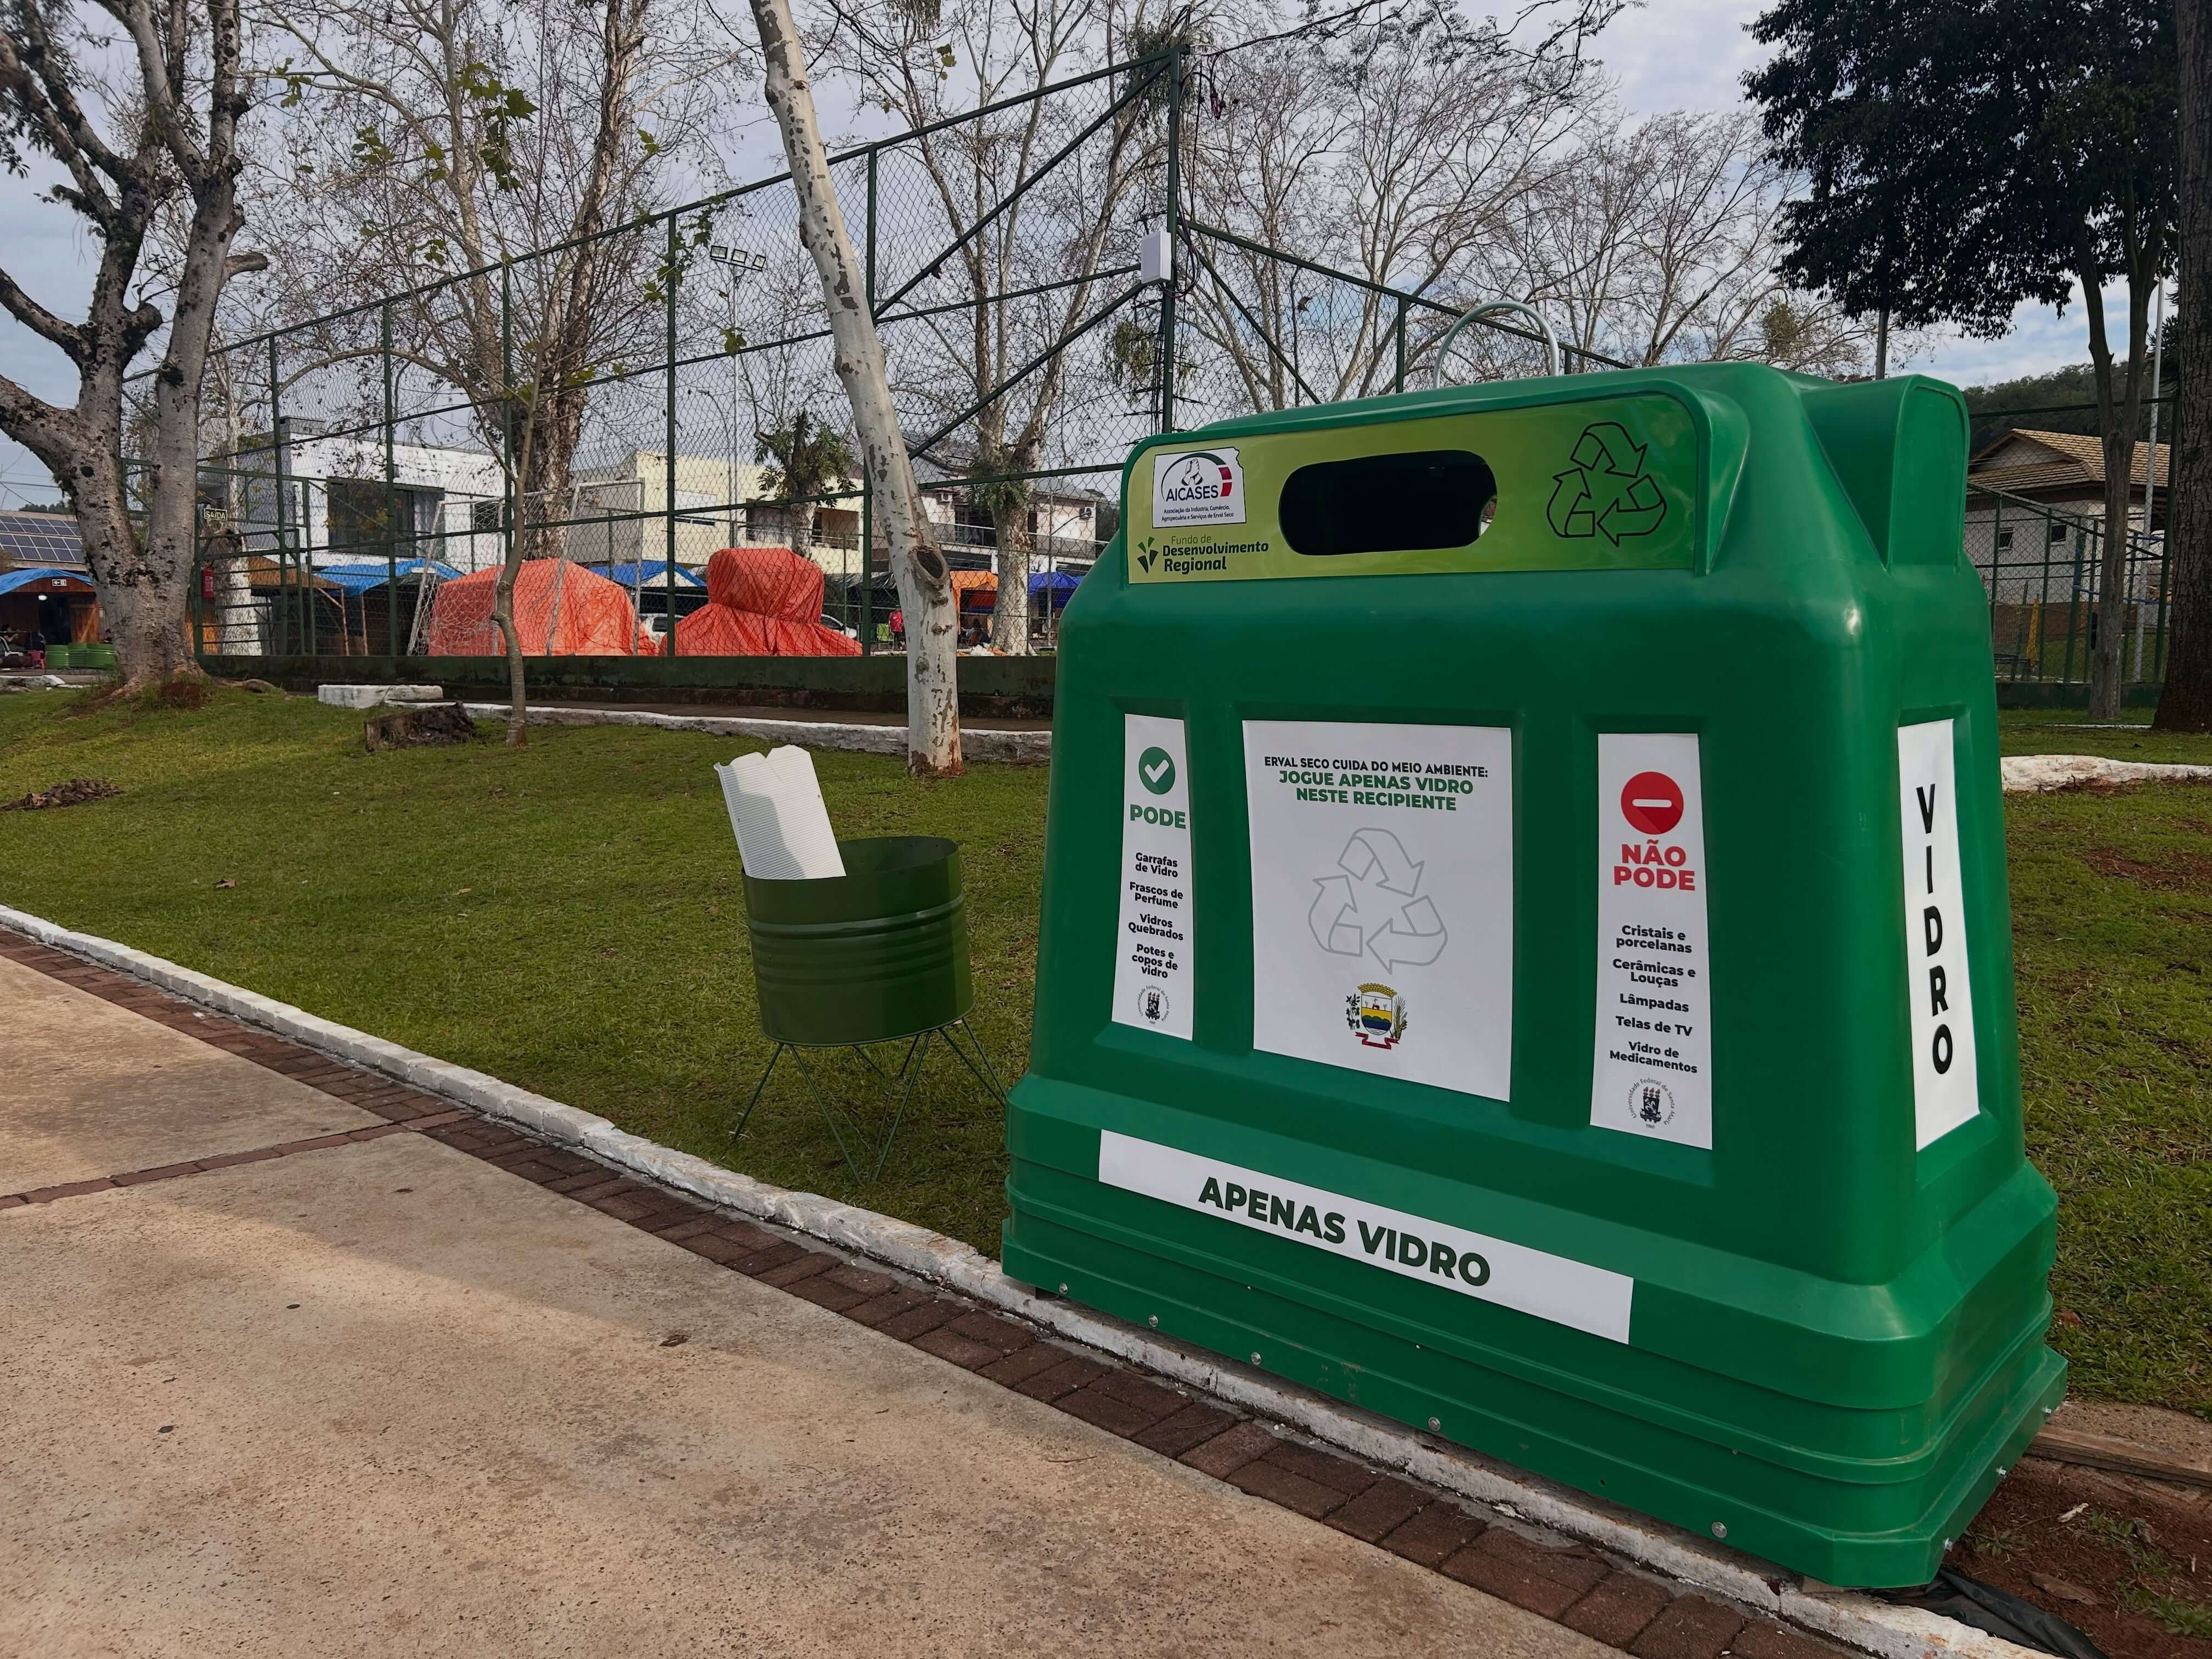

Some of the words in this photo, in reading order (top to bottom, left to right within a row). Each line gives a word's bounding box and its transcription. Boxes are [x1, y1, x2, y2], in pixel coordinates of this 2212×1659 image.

[1166, 485, 1218, 501] AICASES
[1163, 541, 1269, 556] Desenvolvimento
[1171, 534, 1198, 545] Fundo
[1200, 534, 1211, 543] de
[1164, 556, 1227, 574] Regional
[1264, 756, 1298, 768] ERVAL
[1300, 758, 1330, 769] SECO
[1333, 759, 1368, 771] CUIDA
[1371, 761, 1389, 771] DO
[1392, 761, 1421, 774] MEIO
[1425, 763, 1488, 777] AMBIENTE:
[1279, 770, 1334, 786] JOGUE
[1339, 774, 1411, 790] APENAS
[1415, 777, 1474, 794] VIDRO
[1296, 787, 1348, 804] NESTE
[1353, 791, 1457, 811] RECIPIENTE
[1130, 804, 1186, 829] PODE
[1135, 852, 1178, 867] Garrafas
[1621, 839, 1686, 867] NÃO
[1135, 862, 1148, 872] de
[1150, 865, 1178, 878] Vidro
[1613, 866, 1695, 891] PODE
[1130, 881, 1168, 896] Frascos
[1170, 887, 1183, 900] de
[1135, 893, 1178, 909] Perfume
[1139, 913, 1173, 928] Vidros
[1916, 783, 1953, 1075] VIDRO
[1128, 922, 1183, 941] Quebrados
[1622, 924, 1674, 940] Cristais
[1677, 932, 1686, 941] e
[1136, 943, 1165, 958] Potes
[1168, 951, 1175, 960] e
[1616, 936, 1692, 953] porcelanas
[1132, 954, 1160, 968] copos
[1162, 958, 1178, 970] de
[1612, 958, 1684, 977] Cerâmicas
[1688, 969, 1696, 978] e
[1141, 965, 1168, 979] vidro
[1630, 972, 1679, 988] Louças
[1620, 993, 1689, 1012] Lâmpadas
[1615, 1015, 1651, 1030] Telas
[1654, 1021, 1671, 1033] de
[1674, 1024, 1694, 1037] TV
[1628, 1041, 1660, 1055] Vidro
[1662, 1046, 1679, 1059] de
[1610, 1050, 1697, 1074] Medicamentos
[1640, 1077, 1662, 1086] Federal
[1628, 1082, 1640, 1119] Universidade
[1667, 1092, 1675, 1109] Santa
[1663, 1110, 1675, 1125] Maria
[1198, 1176, 1346, 1244] APENAS
[1357, 1219, 1491, 1286] VIDRO
